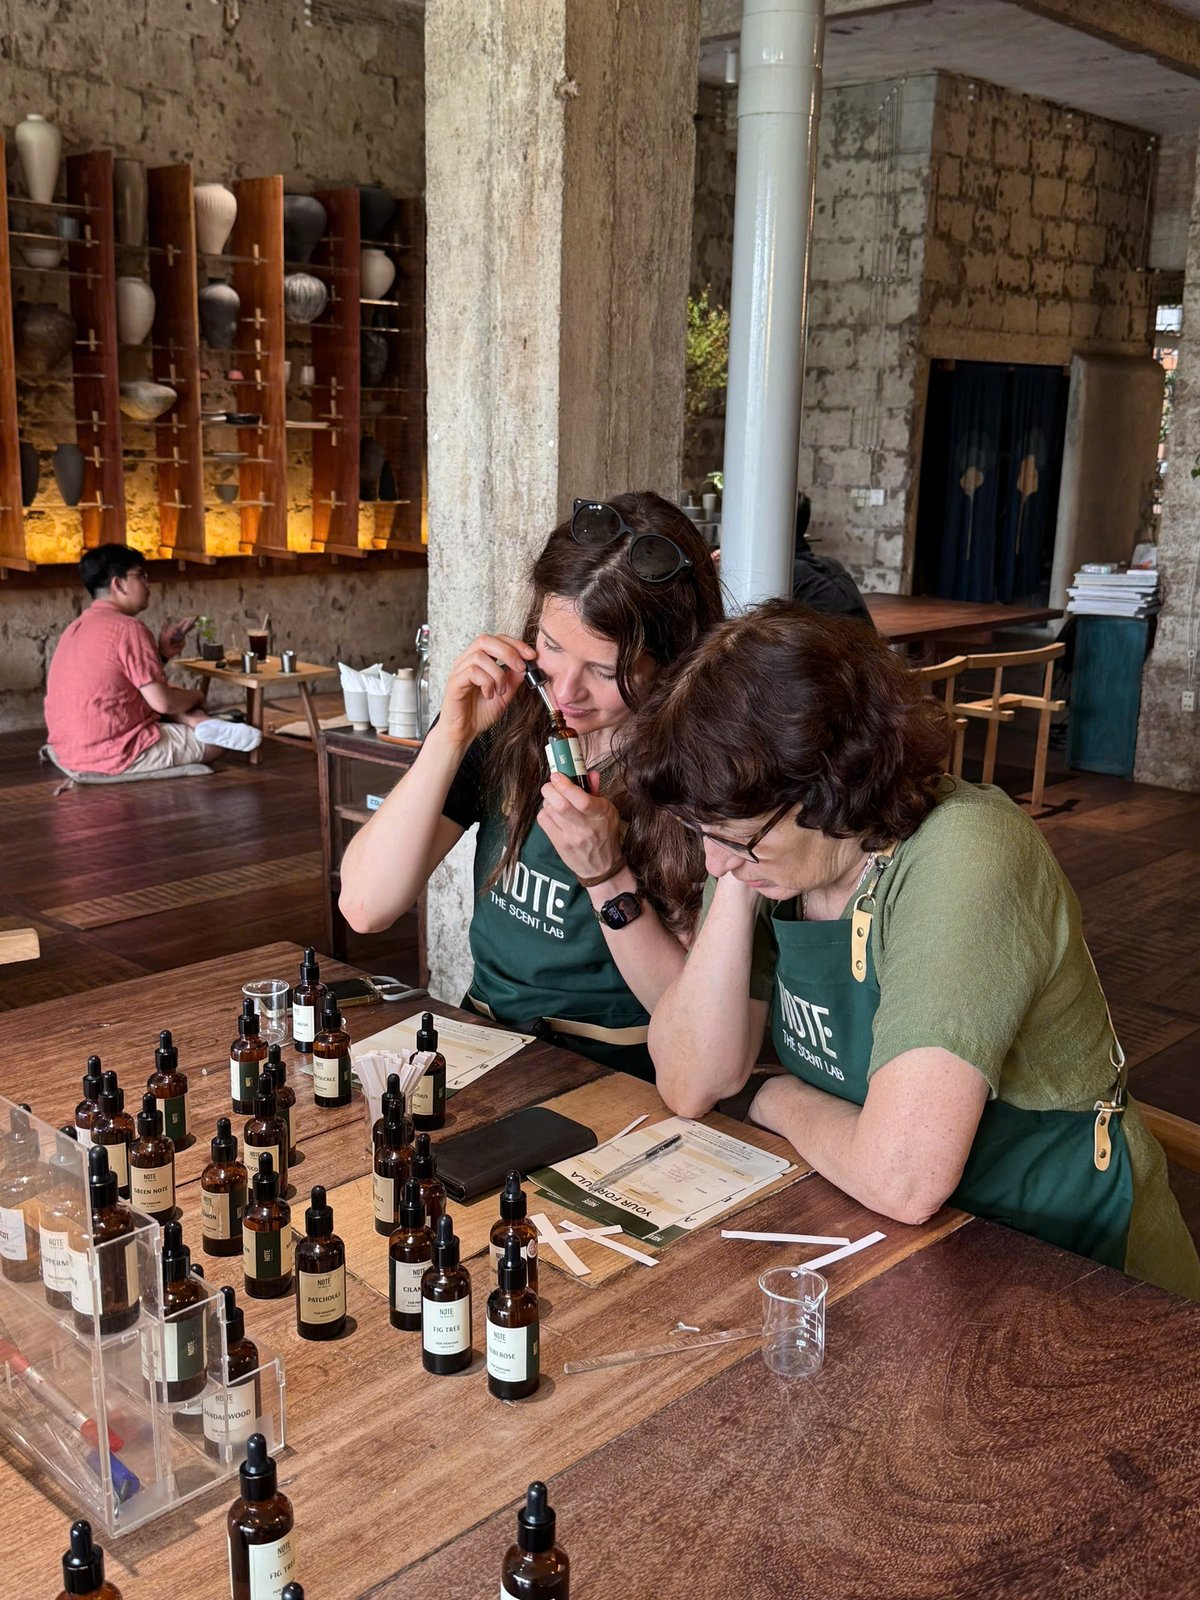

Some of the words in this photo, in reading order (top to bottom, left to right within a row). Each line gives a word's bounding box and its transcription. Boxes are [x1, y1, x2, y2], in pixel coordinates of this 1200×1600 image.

[495, 846, 570, 925] NOTE
[490, 890, 507, 911] THE
[509, 903, 540, 930] SCENT
[543, 921, 565, 939] LAB
[776, 972, 838, 1059] NOTE
[782, 1028, 796, 1052] THE
[797, 1042, 823, 1070] SCENT
[825, 1060, 845, 1081] LAB
[134, 1187, 152, 1195] GREEN
[152, 1185, 168, 1194] NOTE
[620, 1199, 653, 1217] YOUR
[48, 1238, 64, 1247] NOTE
[412, 1267, 425, 1276] NOTE
[317, 1277, 331, 1286] NOTE
[307, 1291, 341, 1303] PATCHOULI
[439, 1307, 454, 1316] NOTE
[445, 1324, 461, 1332] TREE
[493, 1331, 506, 1341] NOTE
[277, 1540, 290, 1555] NOTE
[269, 1569, 282, 1580] FIG
